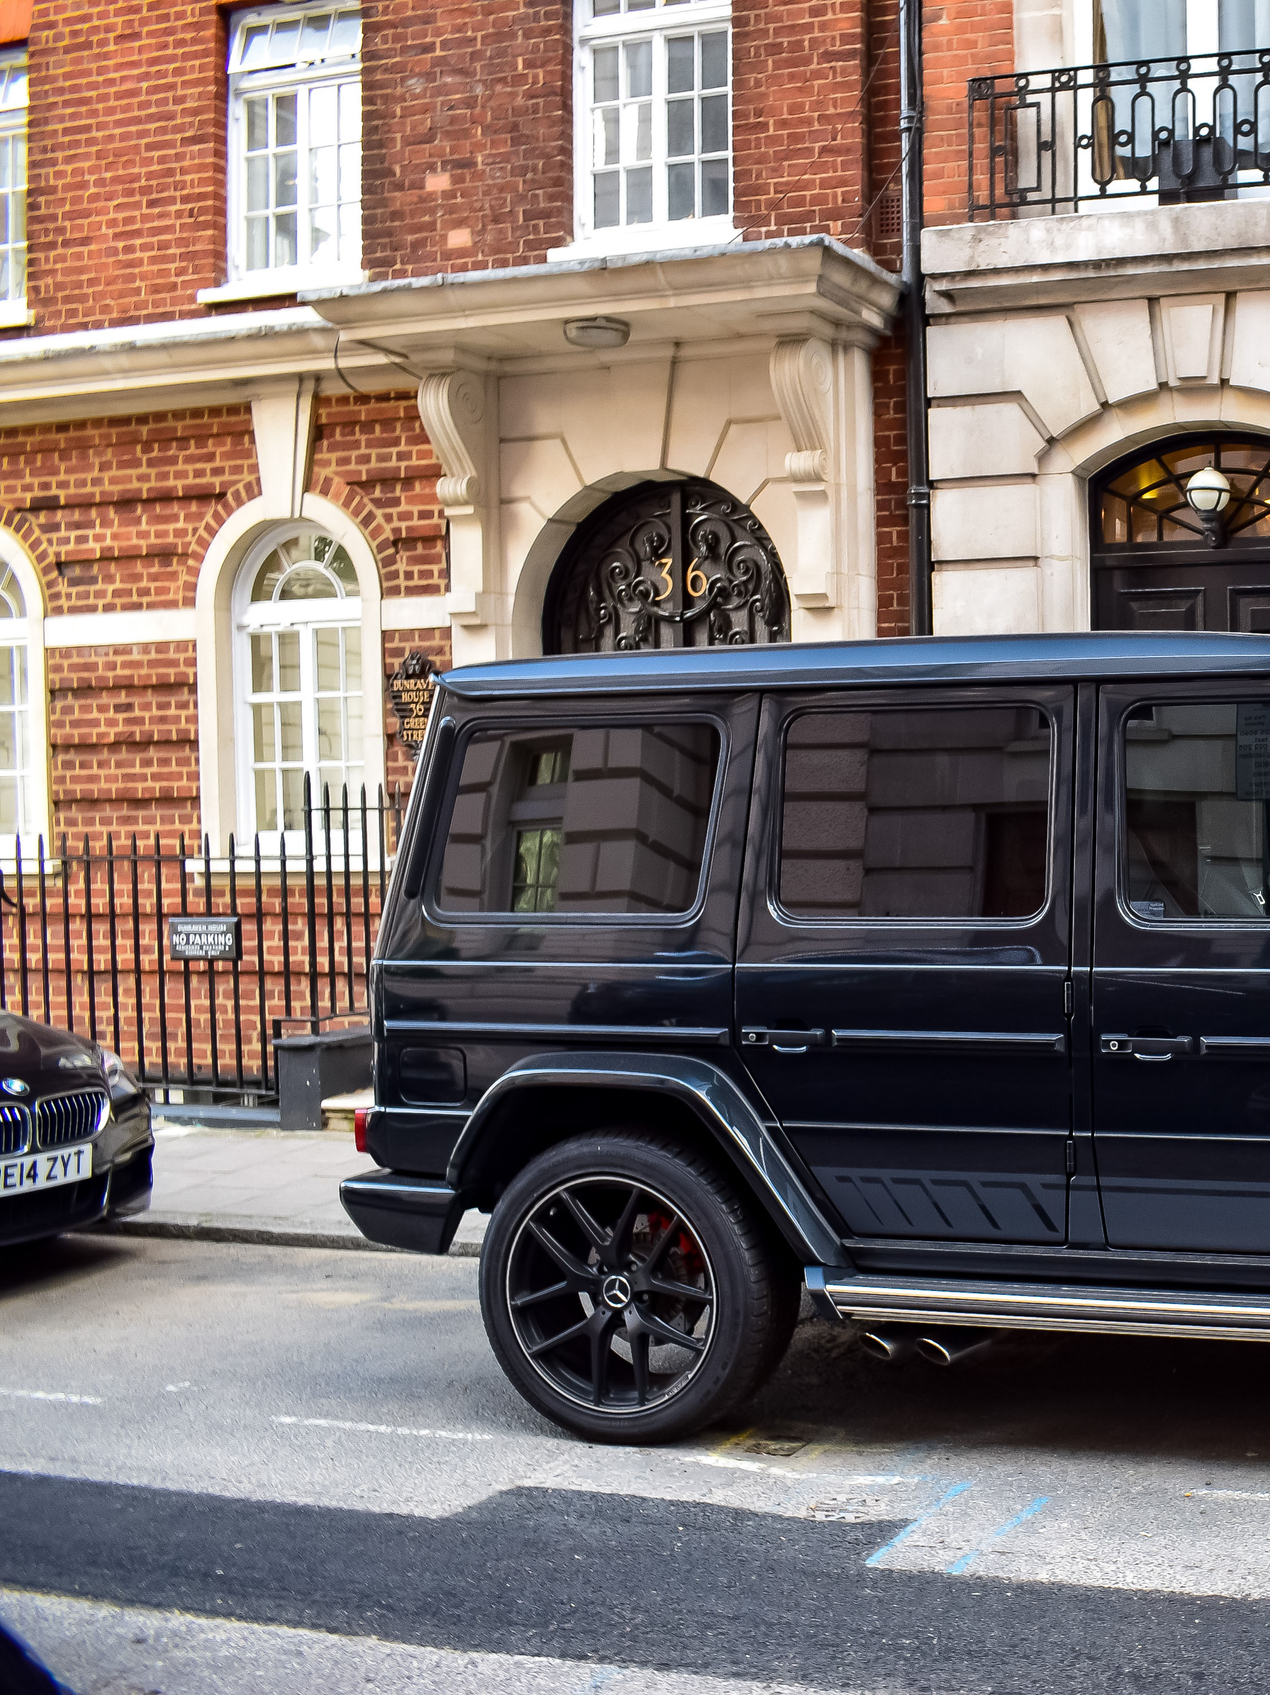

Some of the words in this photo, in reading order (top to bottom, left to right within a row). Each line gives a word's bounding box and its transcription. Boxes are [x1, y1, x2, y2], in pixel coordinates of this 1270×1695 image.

[655, 558, 707, 600] 36
[393, 679, 435, 691] DUNRAVE
[401, 691, 430, 703] HOUSE
[410, 703, 425, 718] 36
[403, 717, 428, 730] GREE
[402, 730, 425, 742] STRE
[172, 933, 187, 946] NO
[189, 933, 233, 946] PARKING
[0, 1159, 38, 1190] E14
[45, 1149, 85, 1182] ZYT
